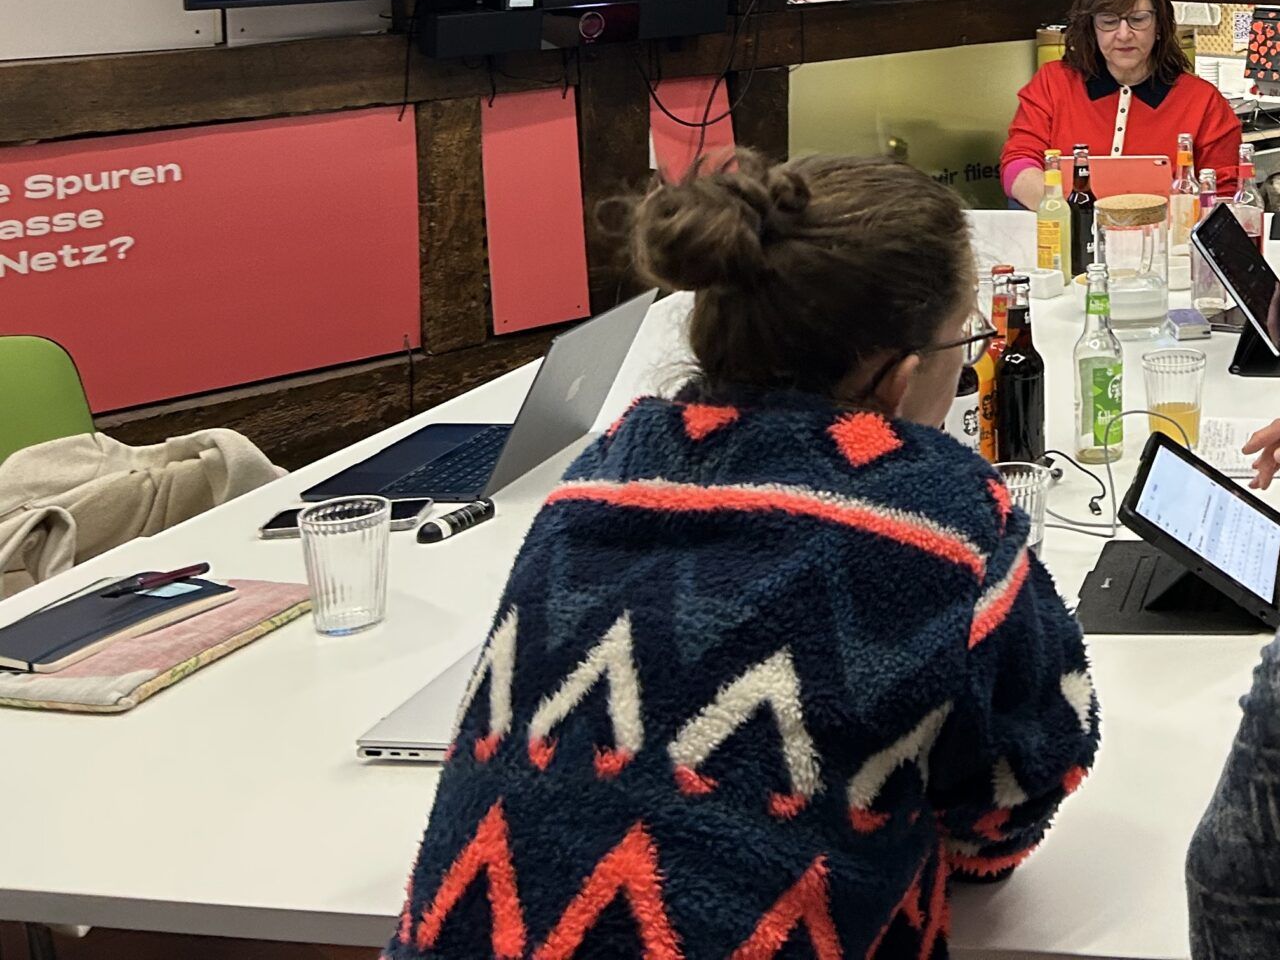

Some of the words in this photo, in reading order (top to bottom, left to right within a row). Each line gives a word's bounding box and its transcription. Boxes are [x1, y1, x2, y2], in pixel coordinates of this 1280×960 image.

[24, 163, 182, 200] Spuren
[0, 208, 104, 240] asse
[0, 236, 135, 277] Netz?
